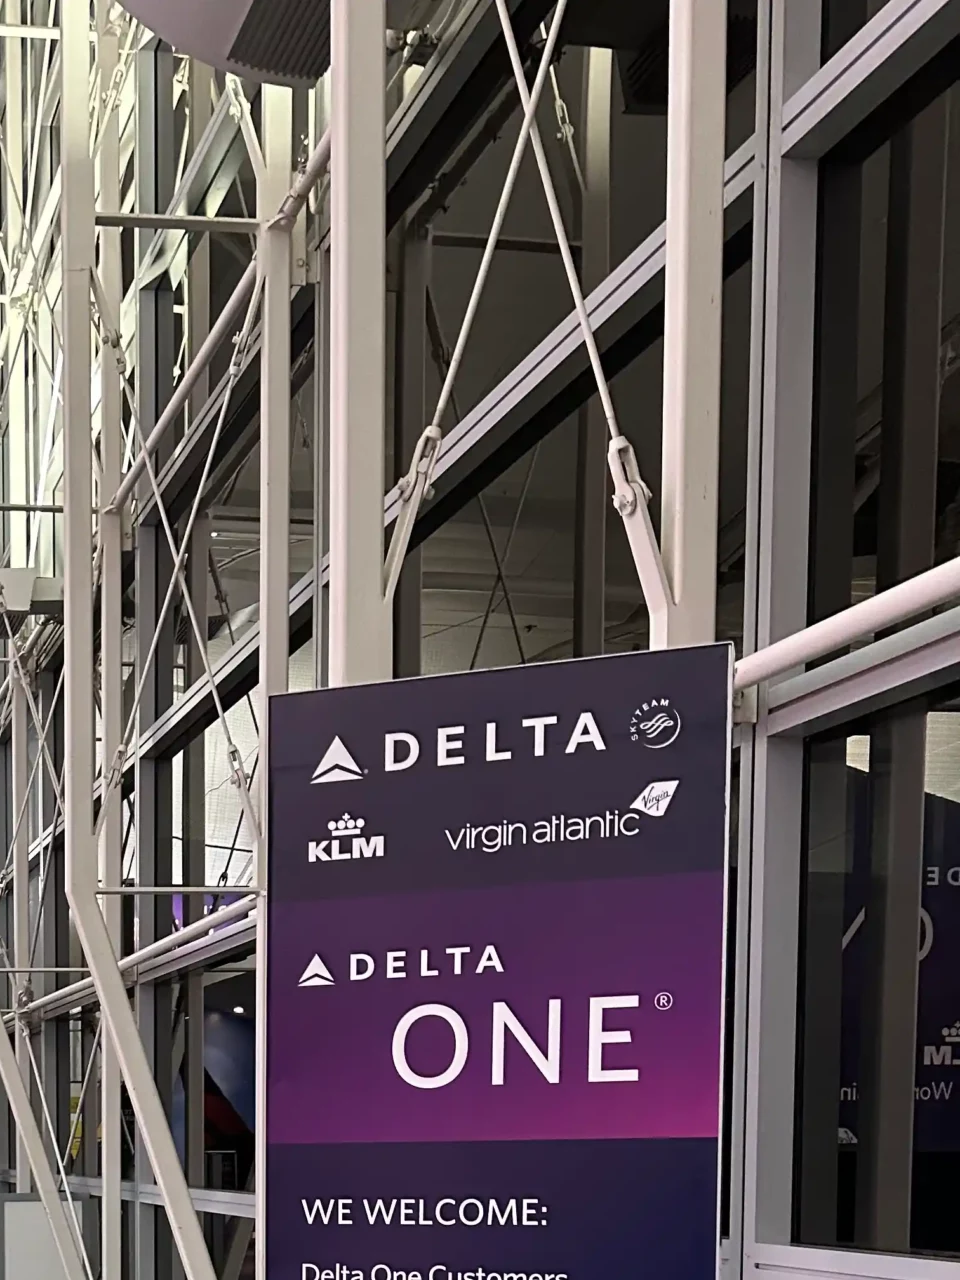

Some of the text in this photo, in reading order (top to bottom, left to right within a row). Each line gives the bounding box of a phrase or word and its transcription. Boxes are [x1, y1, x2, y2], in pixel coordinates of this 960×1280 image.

[629, 698, 670, 741] SKYTEAM
[384, 711, 606, 772] DELTA
[308, 836, 385, 863] KLM
[445, 809, 640, 853] virgin atlantic
[349, 945, 505, 981] DELTA
[301, 1198, 548, 1227] WE WELCOME:
